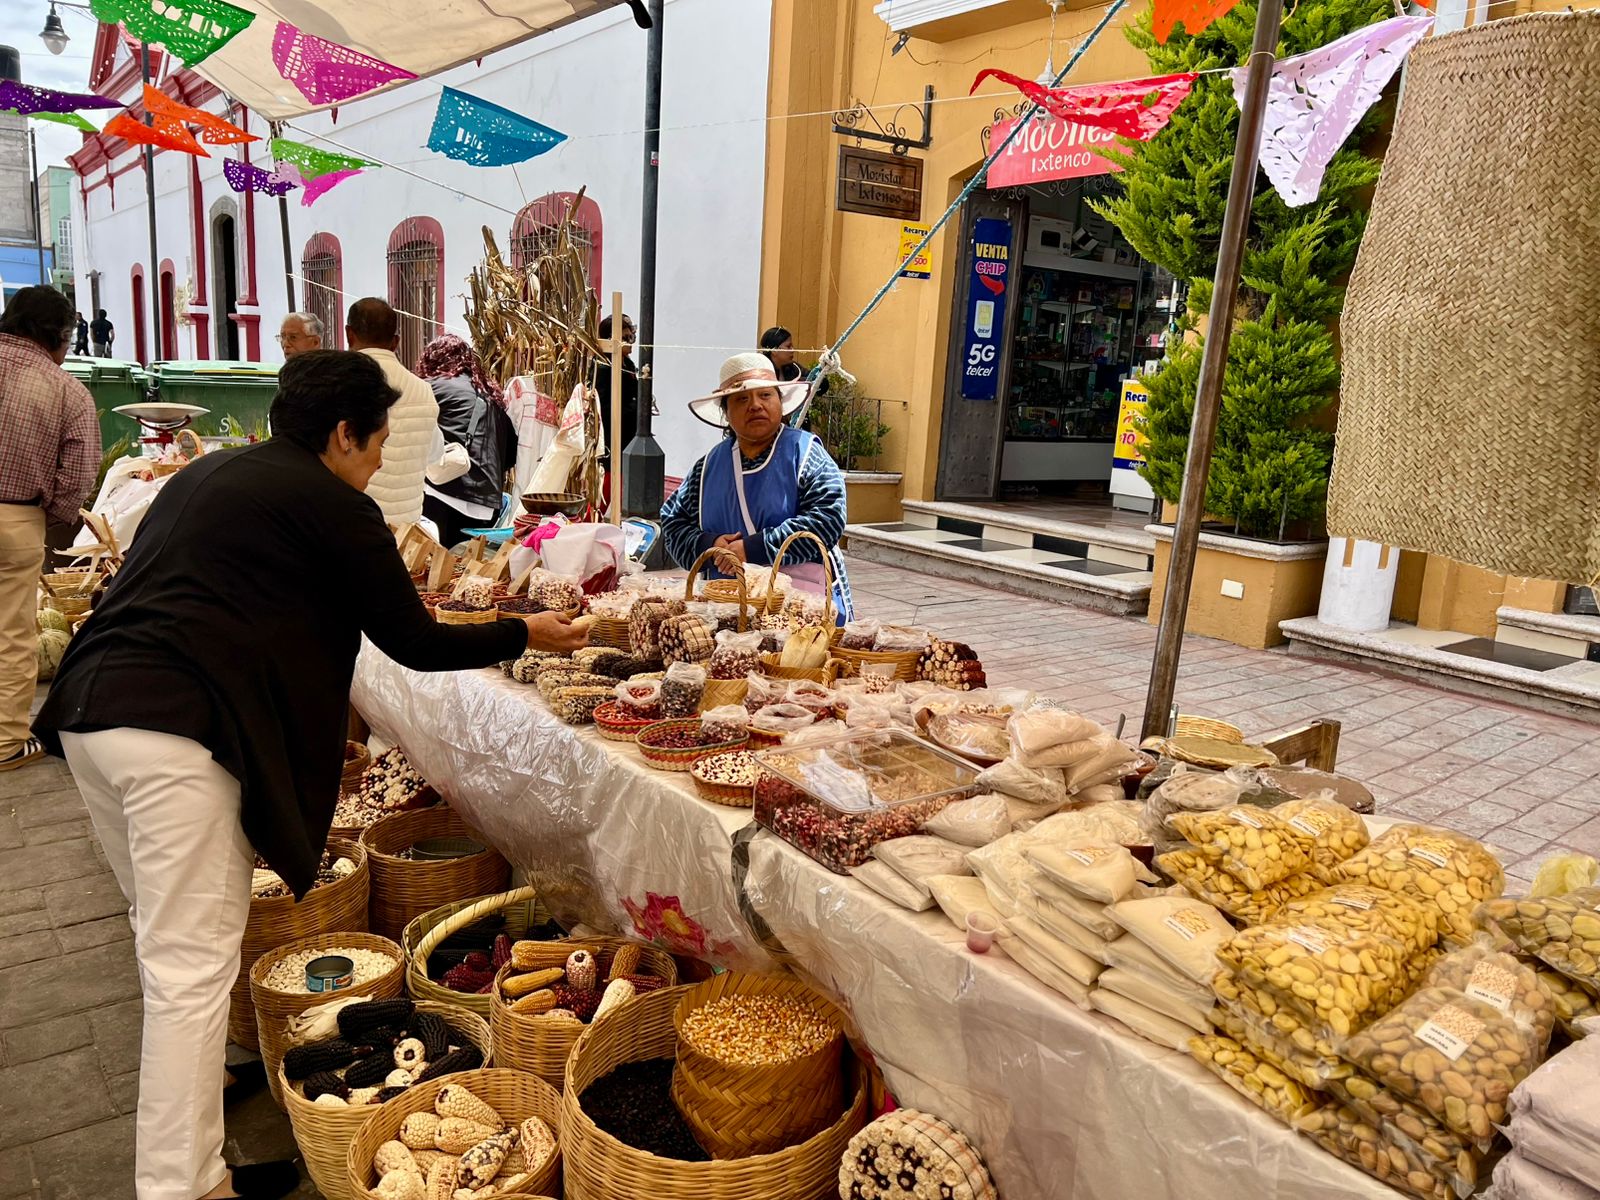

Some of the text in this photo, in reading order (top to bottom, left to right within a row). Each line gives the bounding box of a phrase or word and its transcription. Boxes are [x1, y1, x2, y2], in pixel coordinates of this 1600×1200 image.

[1032, 151, 1092, 174] Ixtenco
[975, 243, 1008, 260] VENTA
[975, 261, 1006, 276] CHIP
[968, 343, 996, 365] 5G
[966, 365, 994, 376] telcel
[1125, 391, 1148, 402] Reca
